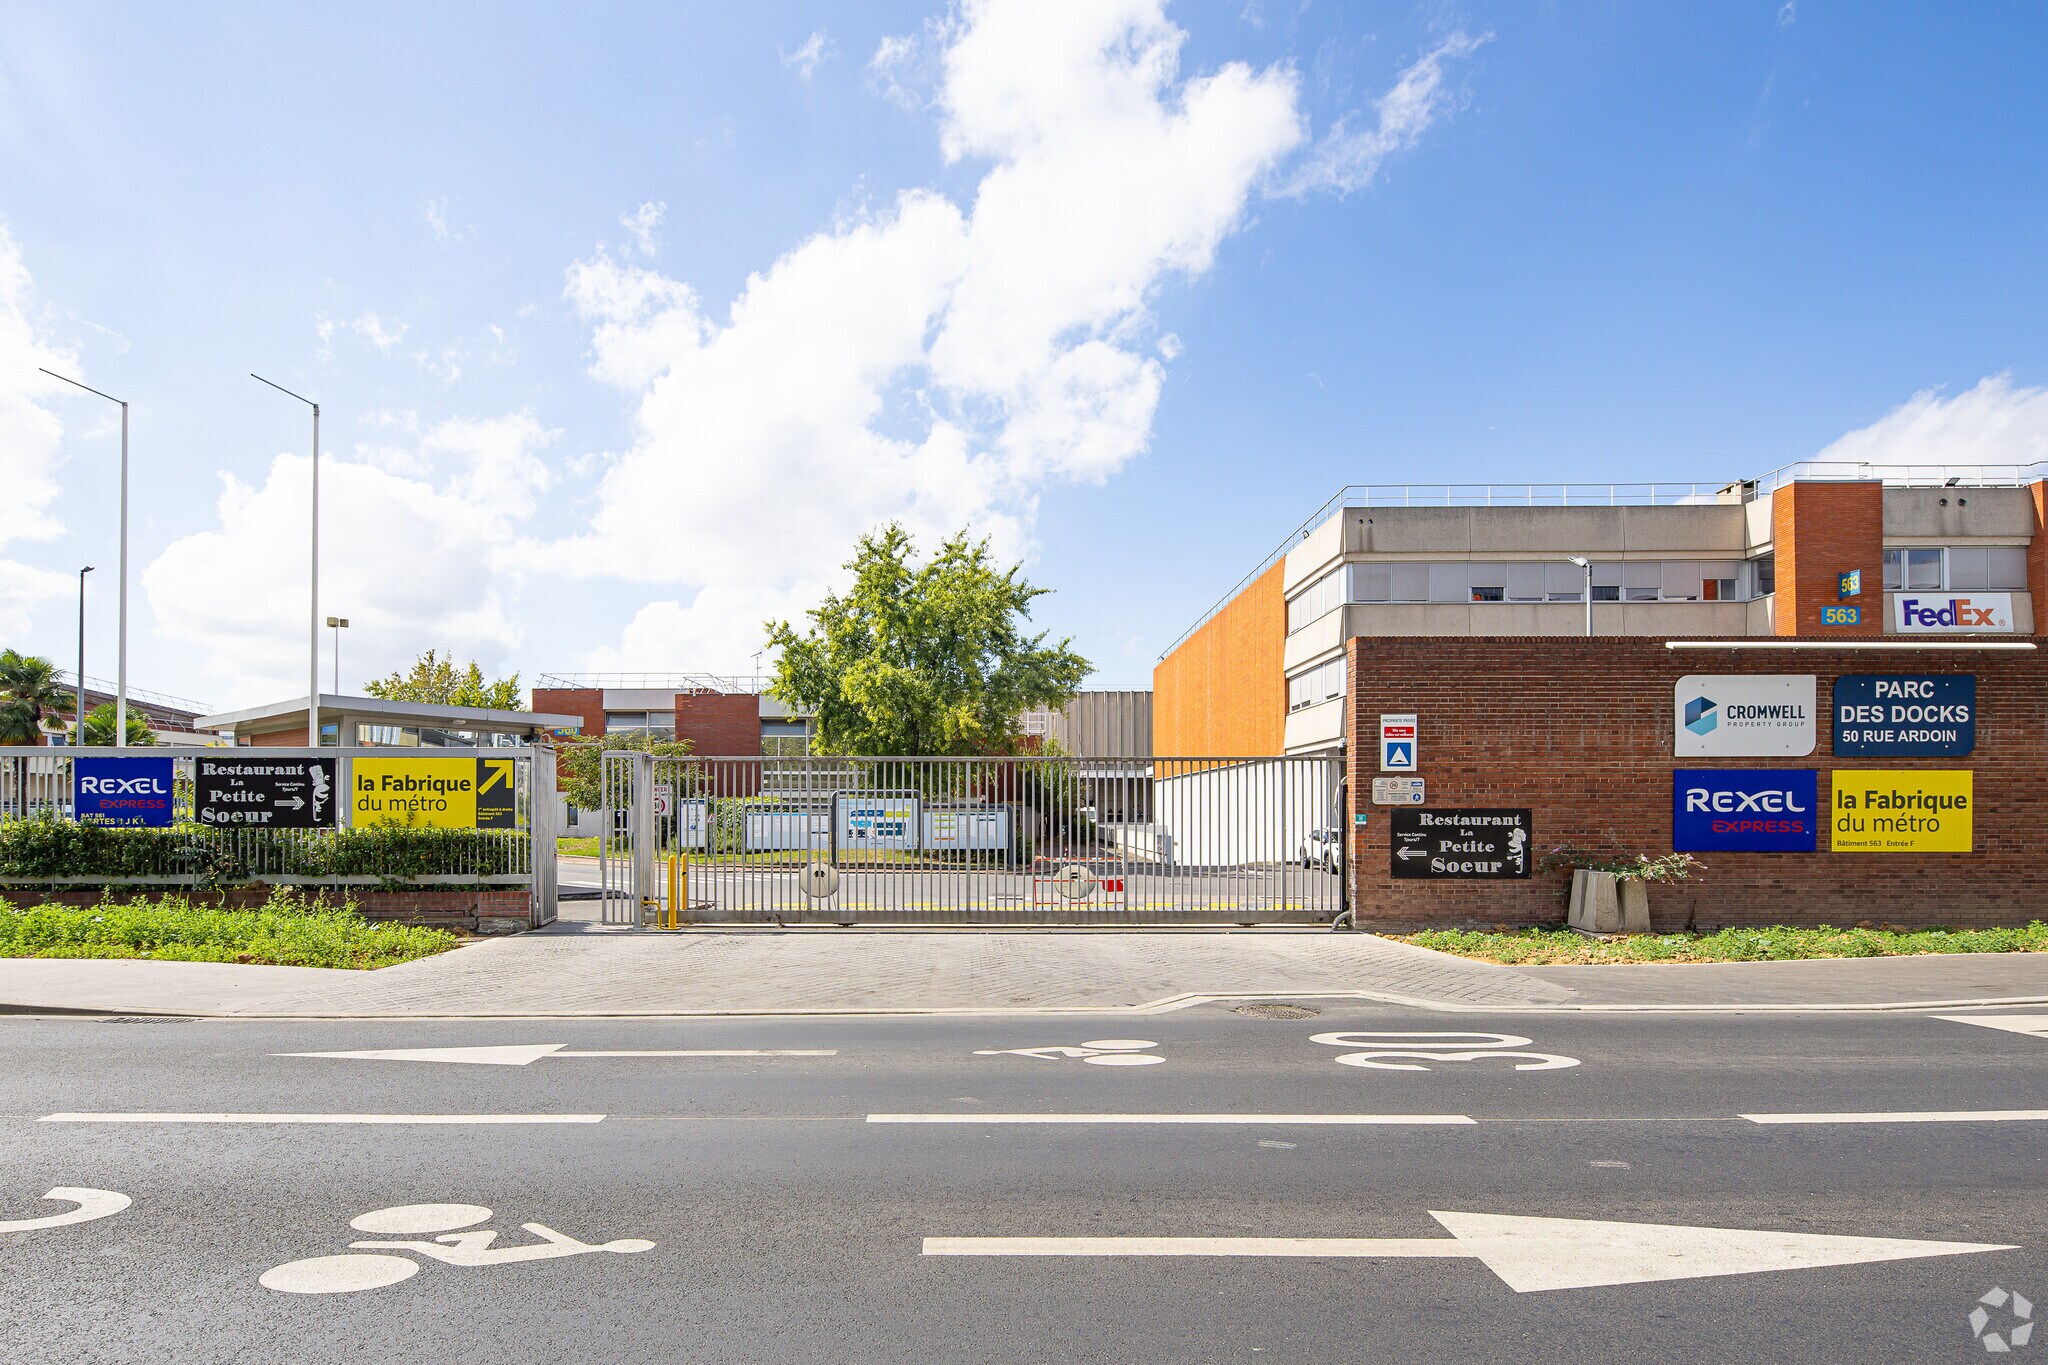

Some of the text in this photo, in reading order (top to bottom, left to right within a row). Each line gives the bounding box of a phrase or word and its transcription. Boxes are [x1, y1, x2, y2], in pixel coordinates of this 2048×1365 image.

[1841, 575, 1859, 593] 563
[1826, 608, 1857, 623] 563
[1902, 598, 1996, 627] FedEx
[1875, 680, 1934, 698] PARC
[1727, 705, 1805, 719] CROMWELL
[1840, 705, 1969, 723] DES DOCKS
[1842, 730, 1957, 742] 50 RUE ARDOIN
[201, 763, 305, 776] Restaurant
[81, 776, 167, 794] REXEL
[357, 774, 471, 796] la Fabrique
[99, 799, 165, 809] EXPRESS
[209, 790, 265, 802] Petite
[357, 793, 447, 811] du métro
[1686, 788, 1806, 812] REXEL
[1837, 789, 1968, 814] la Fabrique
[201, 807, 273, 823] Soeur
[1419, 813, 1522, 826] Restaurant
[1837, 812, 1940, 832] du métro
[1712, 820, 1803, 833] EXPRESS
[1439, 840, 1495, 853] Petite
[1431, 857, 1502, 873] Soeur
